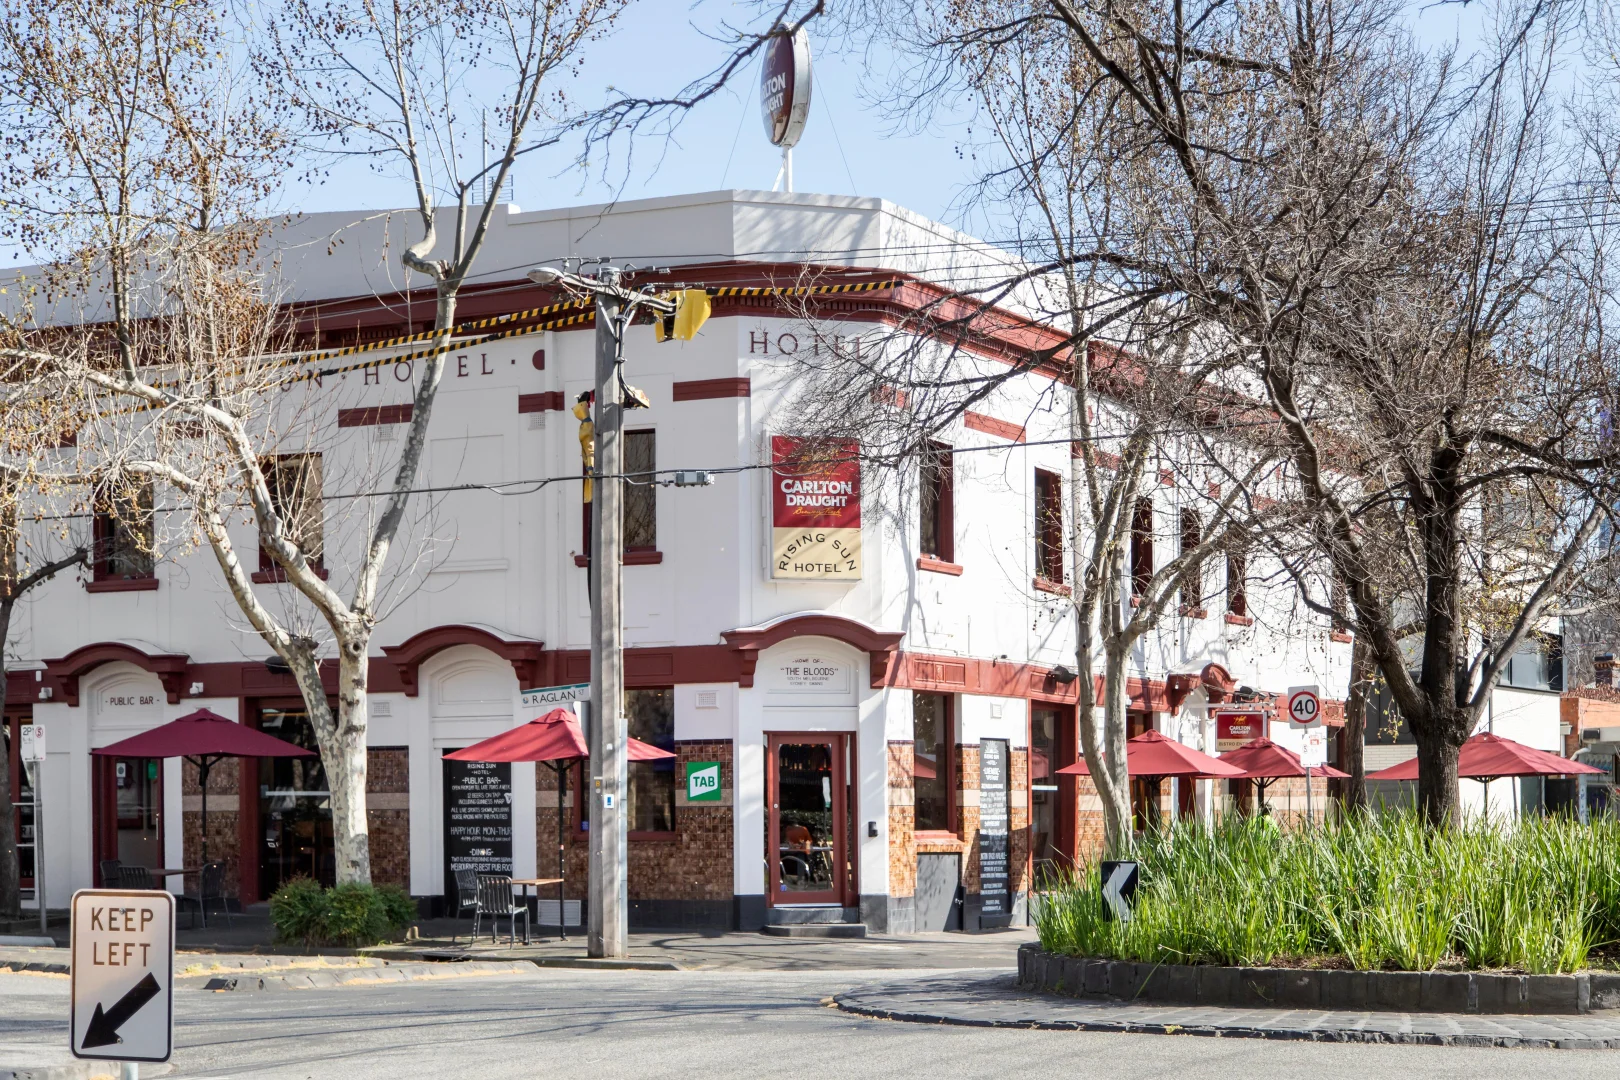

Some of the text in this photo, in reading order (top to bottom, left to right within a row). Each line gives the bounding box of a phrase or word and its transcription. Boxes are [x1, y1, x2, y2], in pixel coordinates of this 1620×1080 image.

[364, 353, 495, 387] HOEL
[780, 479, 852, 494] CARLTON
[785, 494, 848, 507] DRAUGHT
[778, 533, 857, 571] RISING SUN
[794, 563, 842, 573] HOTEL
[110, 695, 154, 706] PUBLIC BAR
[532, 688, 585, 705] RAGLAN ST
[1293, 699, 1315, 715] 40
[693, 776, 715, 788] TAB
[450, 826, 466, 835] HAPPY
[466, 826, 481, 835] HOUR
[479, 863, 491, 871] BEST
[491, 863, 501, 871] PUB
[91, 907, 154, 933] KEEP
[93, 941, 151, 967] LEFT
